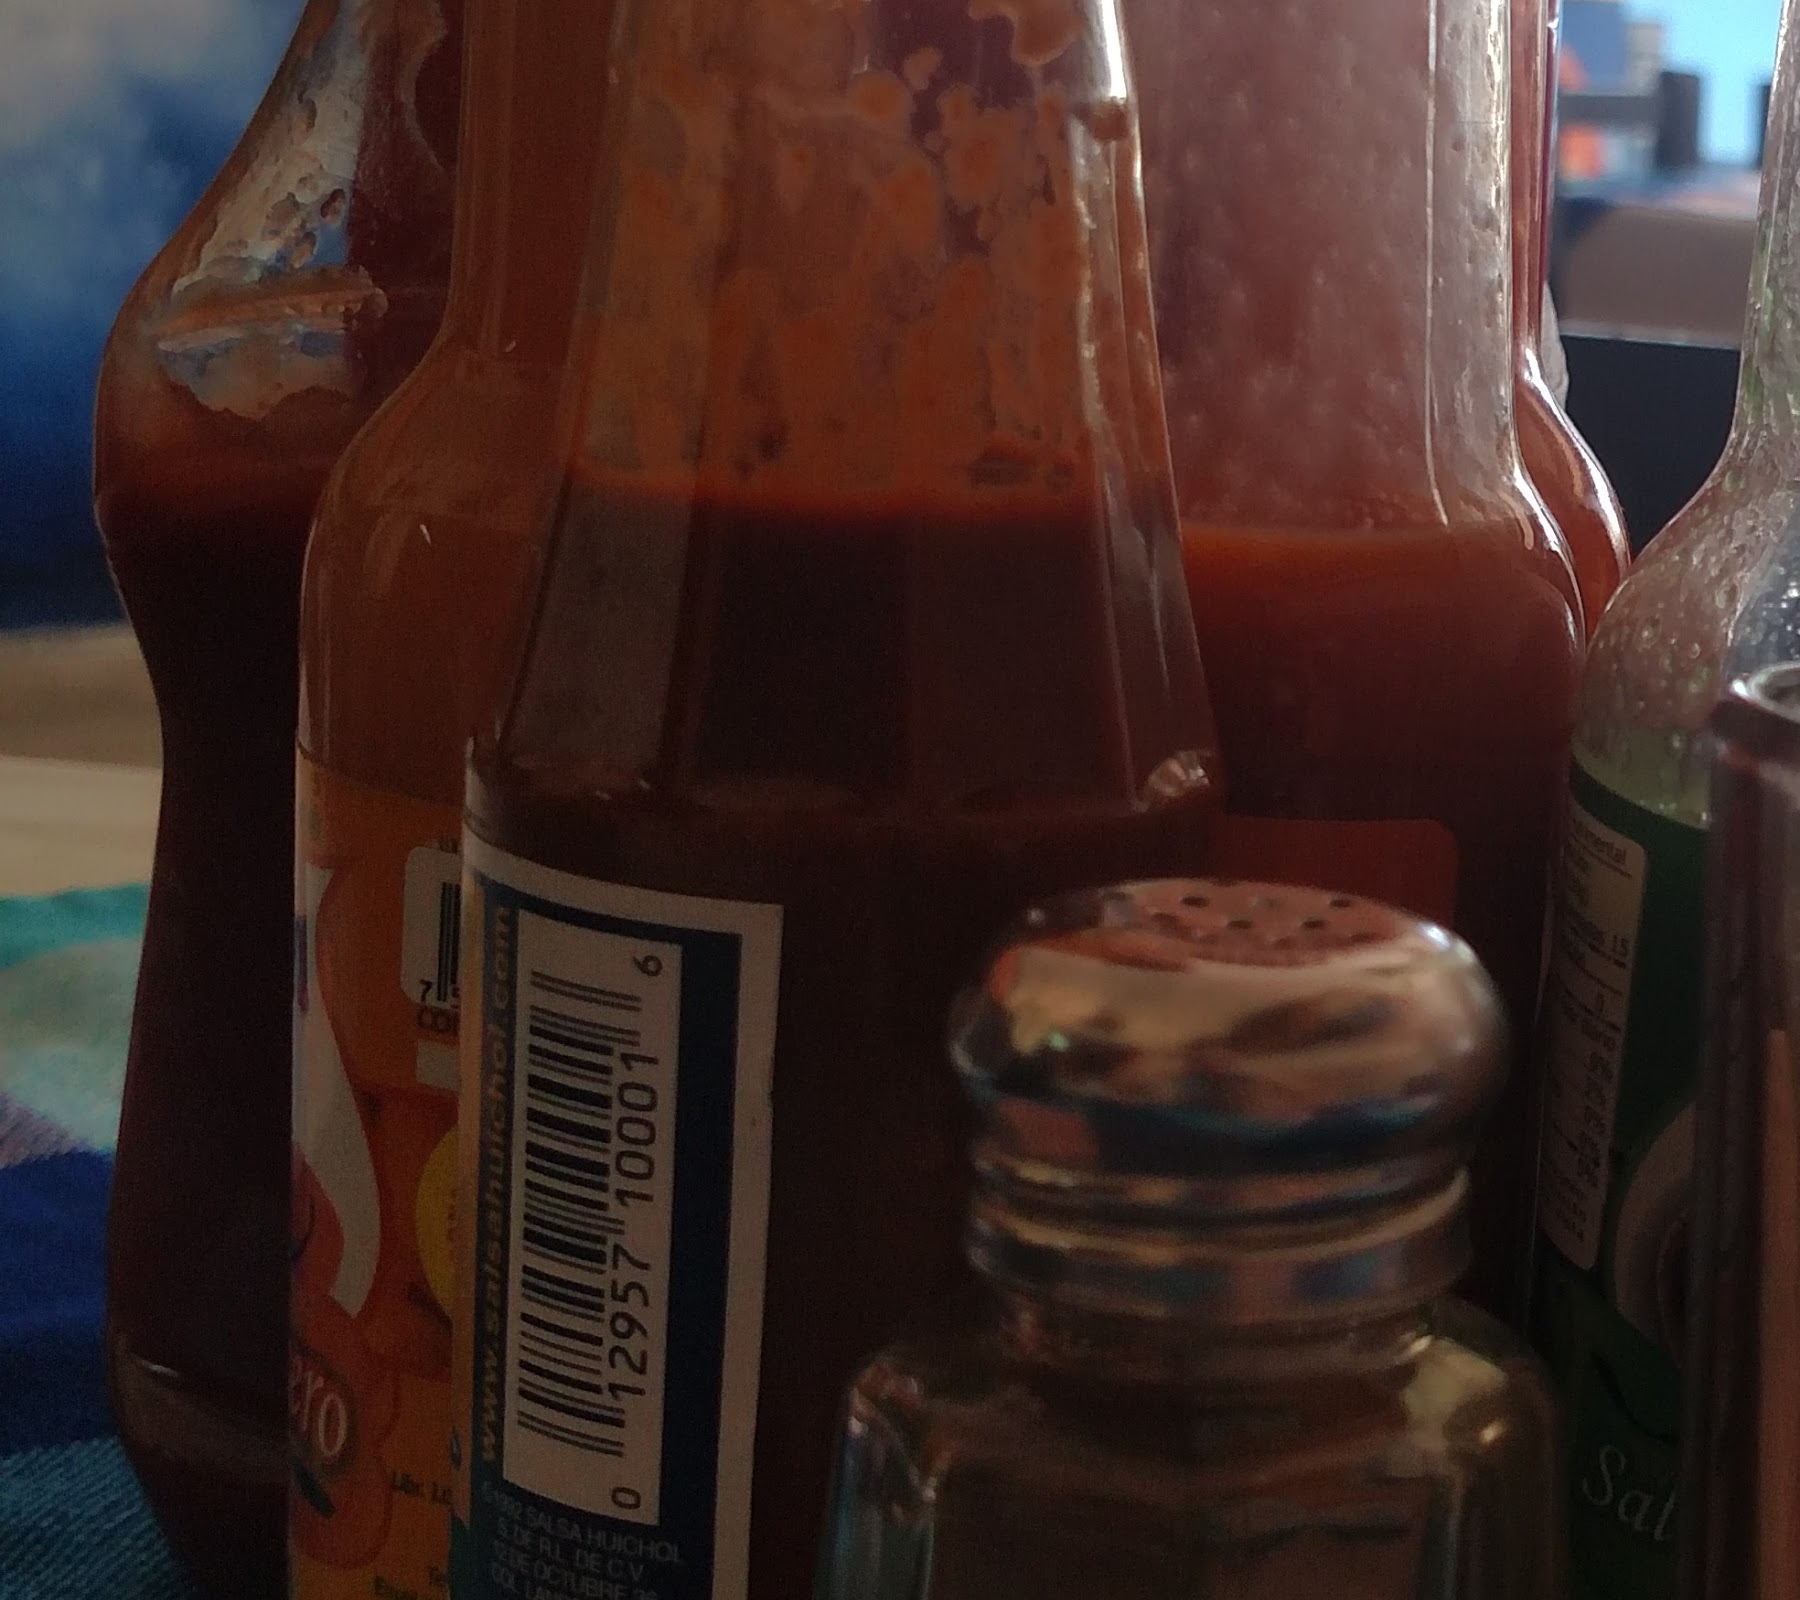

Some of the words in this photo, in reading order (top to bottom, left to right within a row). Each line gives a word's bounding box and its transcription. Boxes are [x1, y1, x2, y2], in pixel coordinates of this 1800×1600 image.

[633, 955, 664, 978] 6
[611, 1050, 660, 1210] 10001
[608, 1245, 651, 1404] 12957
[612, 1486, 641, 1510] 0
[527, 1506, 583, 1543] SALSA
[574, 1549, 603, 1576] DE
